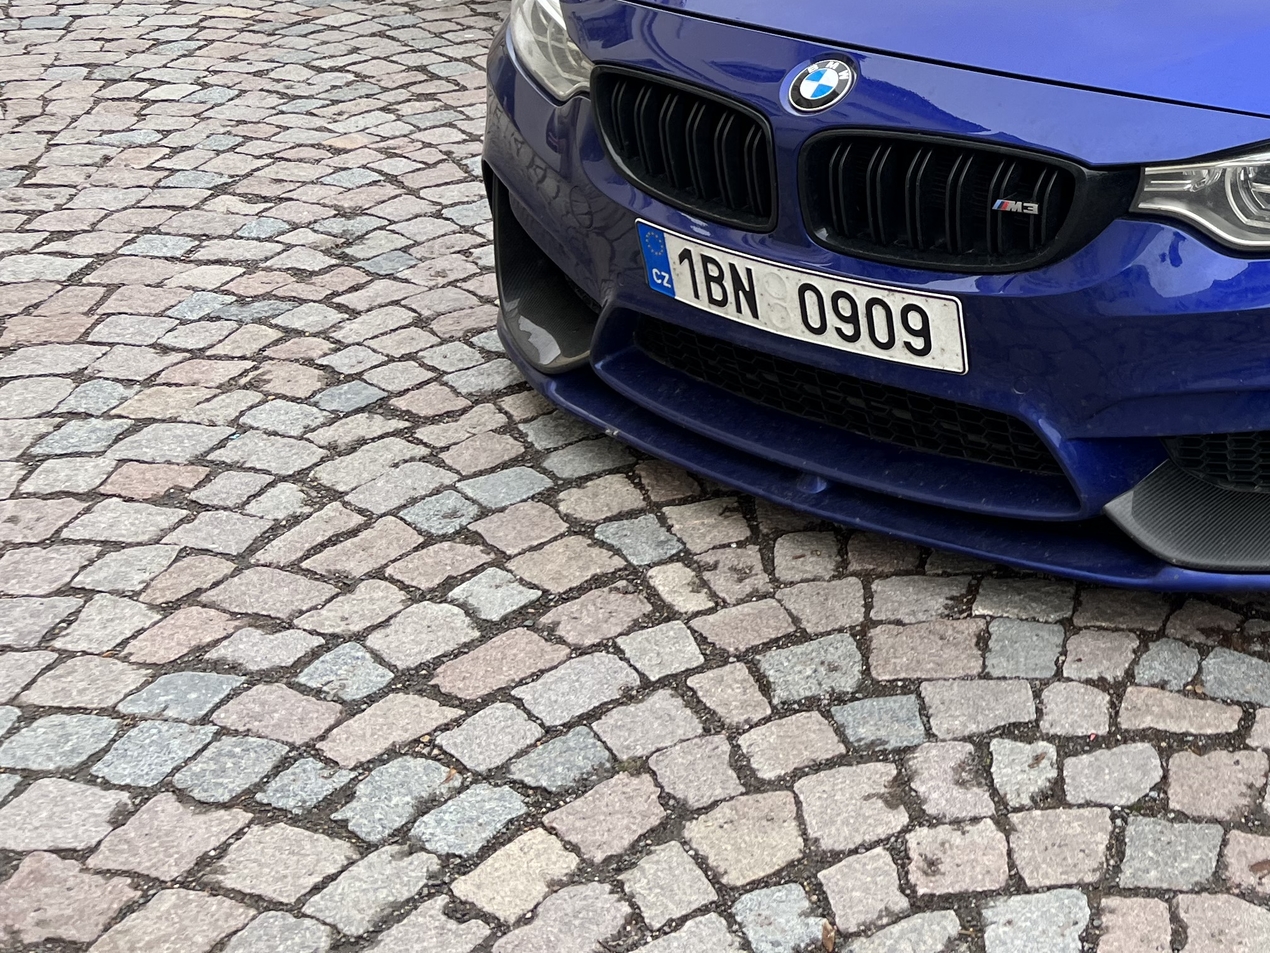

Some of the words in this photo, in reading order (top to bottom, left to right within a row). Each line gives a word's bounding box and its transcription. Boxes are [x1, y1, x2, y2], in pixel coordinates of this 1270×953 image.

[808, 61, 849, 79] BMW
[652, 268, 671, 288] CZ
[678, 248, 759, 319] 1BN
[797, 283, 932, 356] 0909
